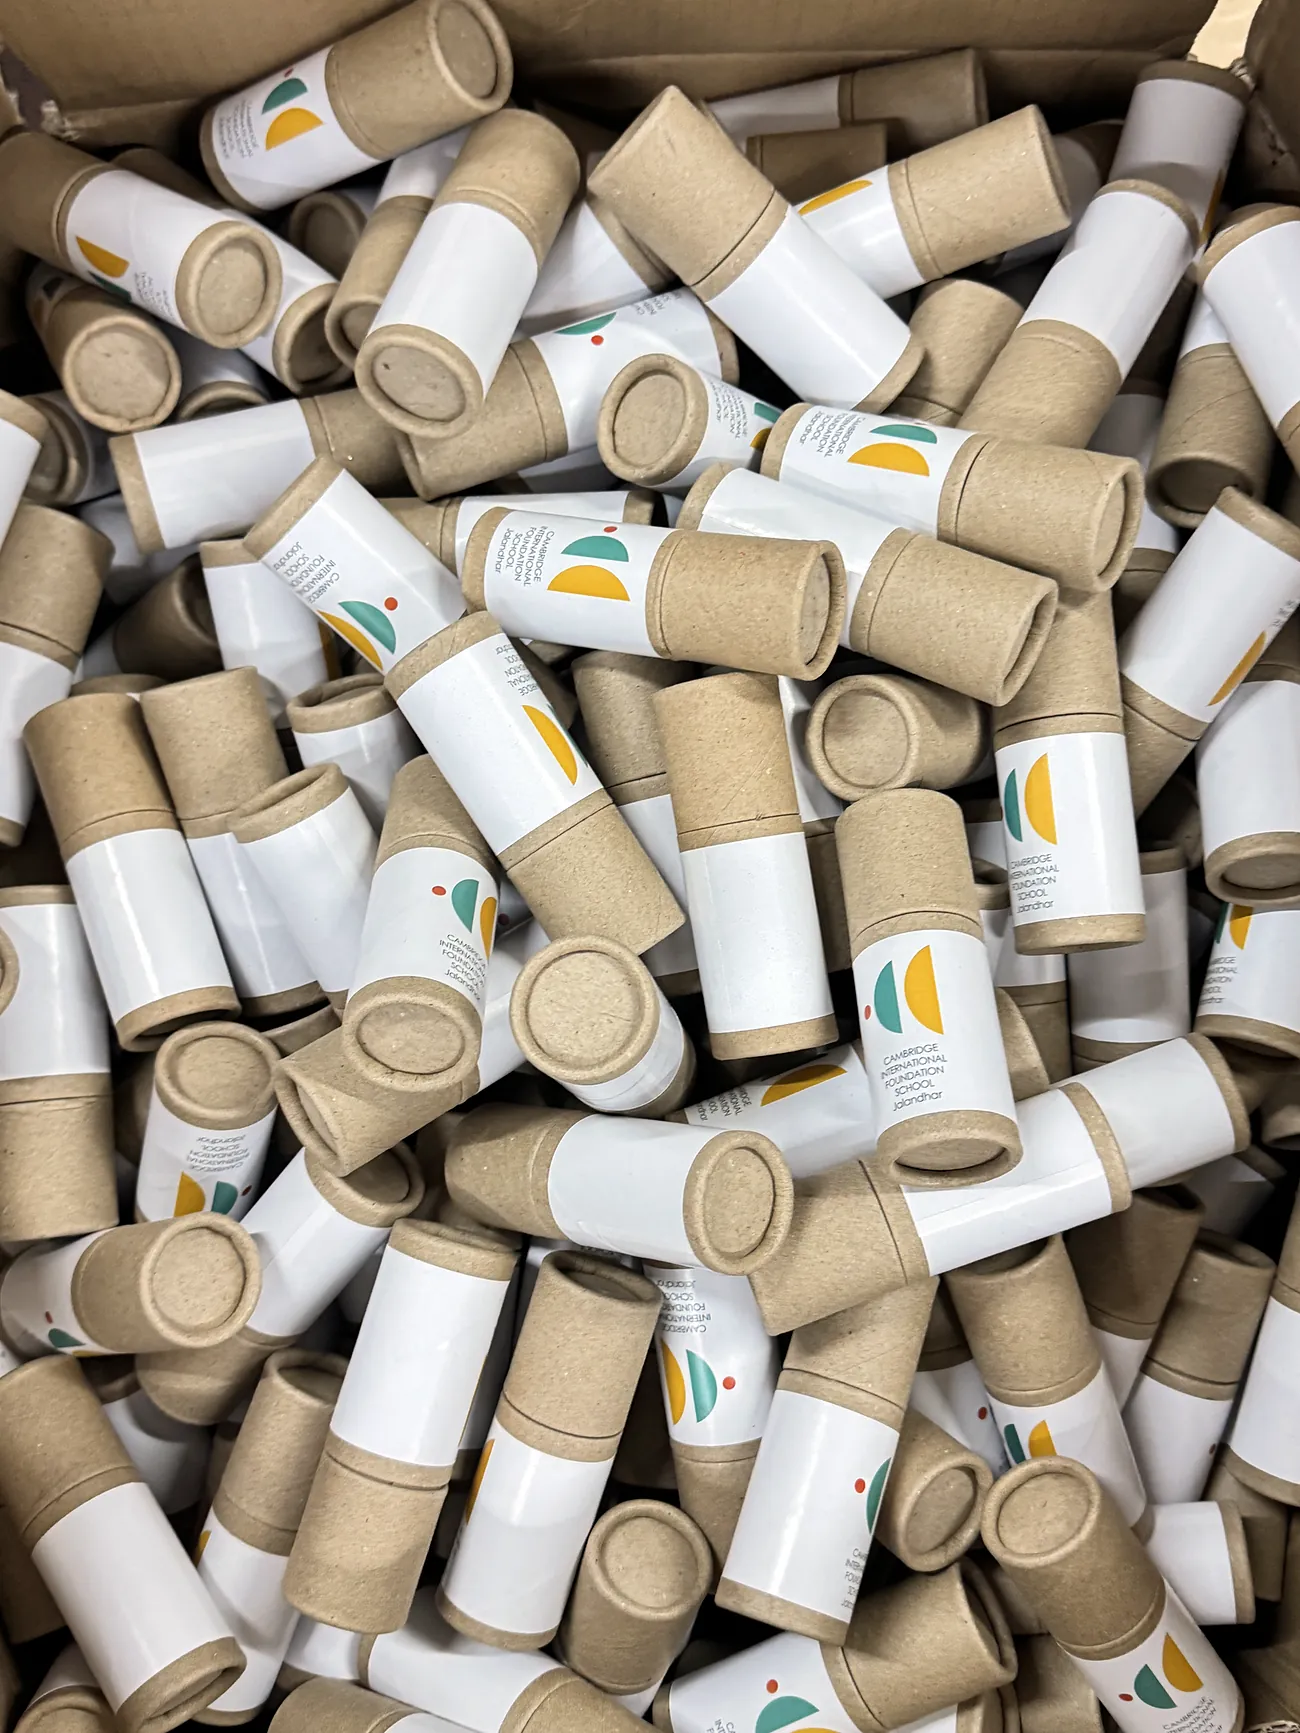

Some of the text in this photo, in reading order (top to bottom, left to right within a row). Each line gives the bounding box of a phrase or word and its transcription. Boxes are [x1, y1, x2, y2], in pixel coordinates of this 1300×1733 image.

[800, 411, 823, 445] Jalandhar
[810, 414, 833, 441] SCHOOL
[816, 412, 848, 452] FOUNDATION
[836, 416, 866, 455] CAMBRIDGE
[495, 528, 514, 573] Jalandhar
[505, 532, 523, 569] SCHOOL
[514, 526, 537, 582] FOUNDATION
[523, 525, 548, 587] INTERNATIONAL
[533, 530, 555, 582] CAMBRIDGE
[284, 553, 310, 577] SCHOOL
[1017, 888, 1048, 901] SCHOOL
[450, 961, 480, 990] SCHOOL
[881, 1054, 948, 1080] INTERNATIONAL
[883, 1043, 939, 1066] CAMBRIDGE
[885, 1065, 945, 1089] FOUNDATION
[894, 1078, 936, 1097] SCHOOL
[893, 1091, 943, 1112] Jalandhar
[196, 1134, 246, 1144] Jalandhar
[201, 1143, 240, 1152] SCHOOL
[189, 1147, 249, 1159] FOUNDATION
